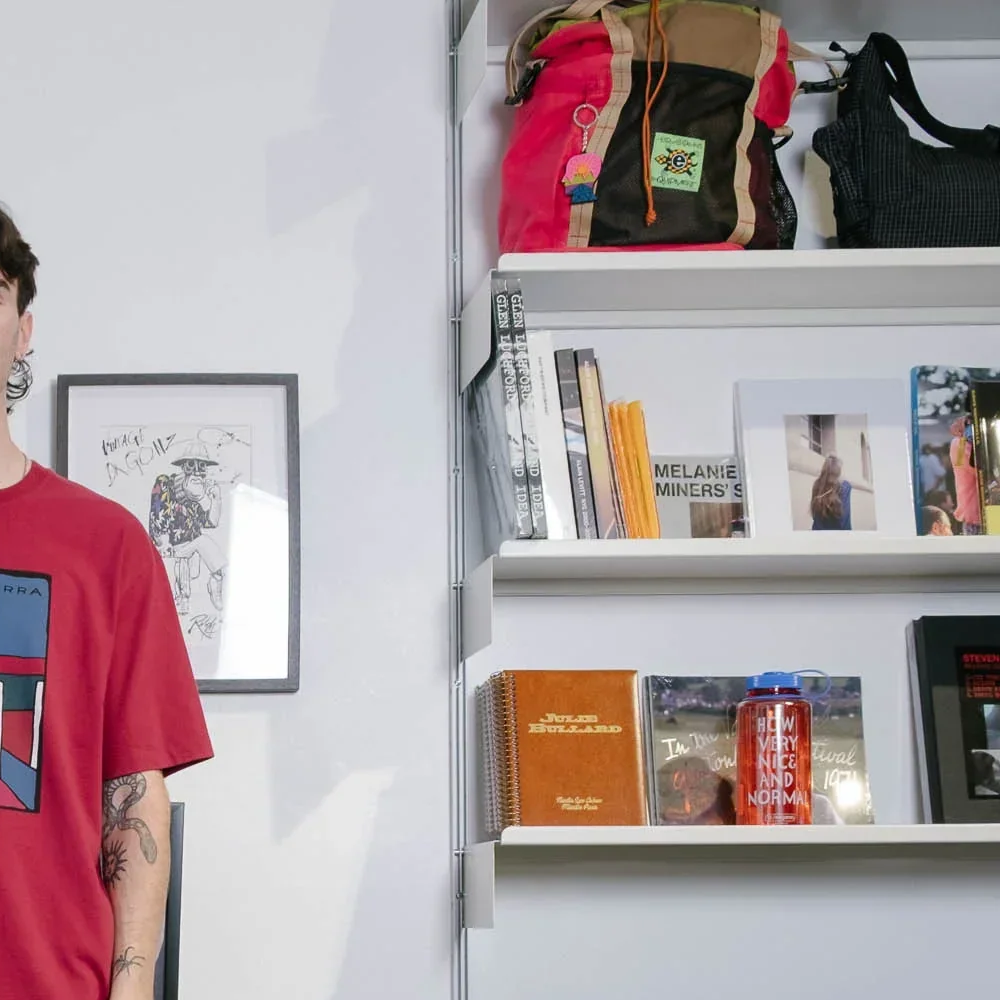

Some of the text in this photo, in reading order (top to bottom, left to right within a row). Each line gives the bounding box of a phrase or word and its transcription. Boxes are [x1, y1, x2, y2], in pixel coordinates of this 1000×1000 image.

[496, 294, 509, 328] GLEN
[511, 294, 524, 328] GLEN
[654, 463, 737, 479] MELANIE
[515, 485, 529, 519] IDEA
[531, 485, 544, 519] IDEA
[528, 723, 622, 734] BULLARD
[758, 716, 795, 732] HOW
[758, 735, 798, 751] VERY
[758, 754, 797, 769] NICE
[760, 772, 794, 788] AND
[748, 789, 809, 806] NORMAL
